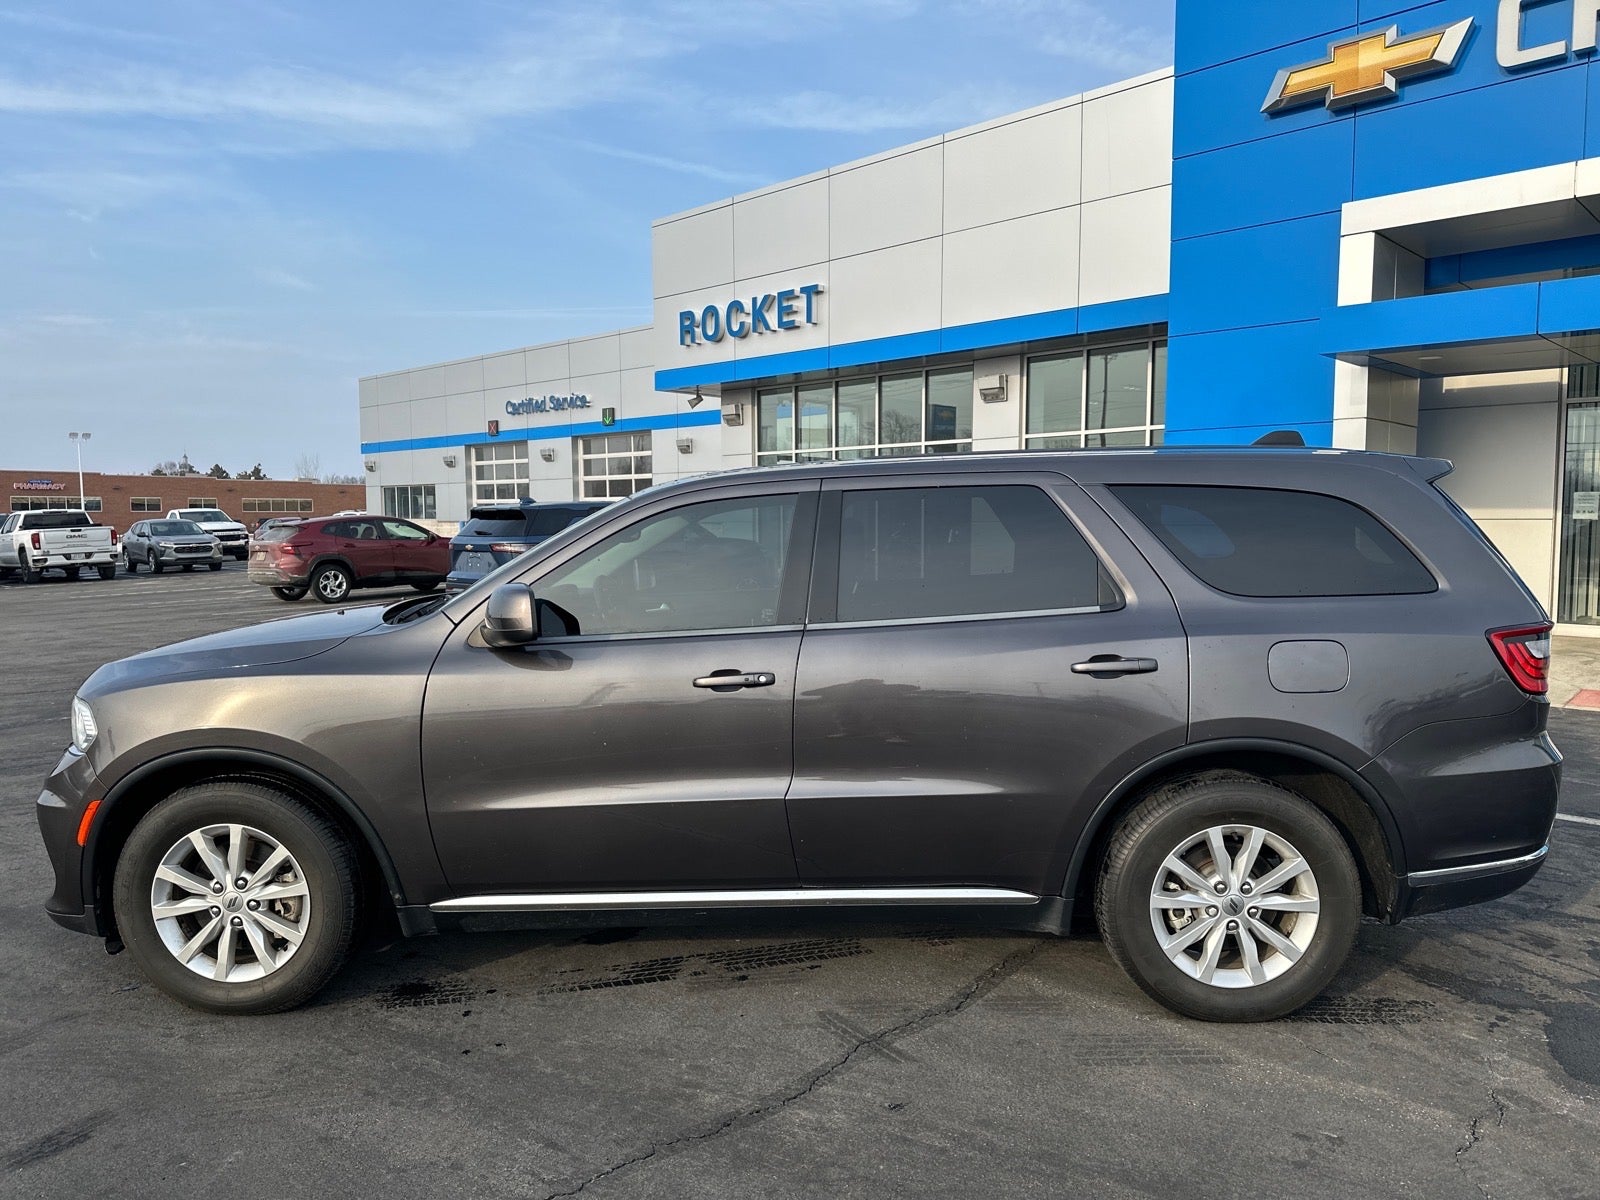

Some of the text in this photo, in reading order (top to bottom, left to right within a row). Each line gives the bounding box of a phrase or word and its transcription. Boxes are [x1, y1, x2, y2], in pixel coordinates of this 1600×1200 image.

[679, 284, 823, 346] ROCKET
[505, 392, 589, 415] Certified Service
[13, 482, 66, 490] PHARMACY
